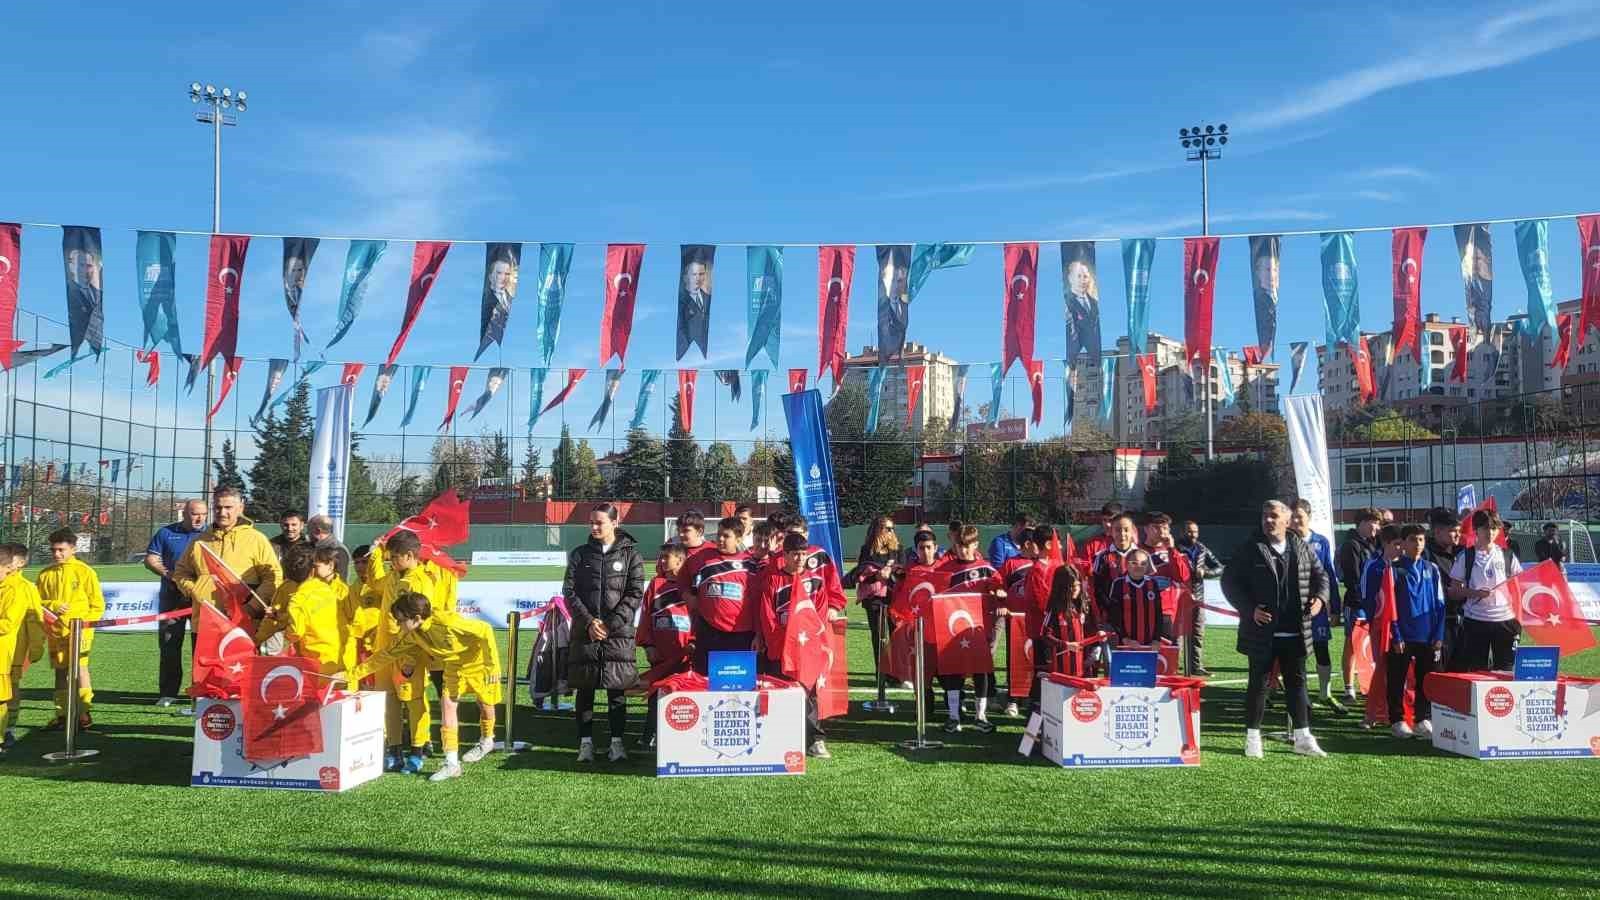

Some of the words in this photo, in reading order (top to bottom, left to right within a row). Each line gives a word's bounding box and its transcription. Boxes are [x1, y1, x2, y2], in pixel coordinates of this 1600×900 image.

[116, 600, 153, 611] TESİSİ
[1115, 705, 1149, 713] DESTEK
[713, 710, 750, 719] DESTEK
